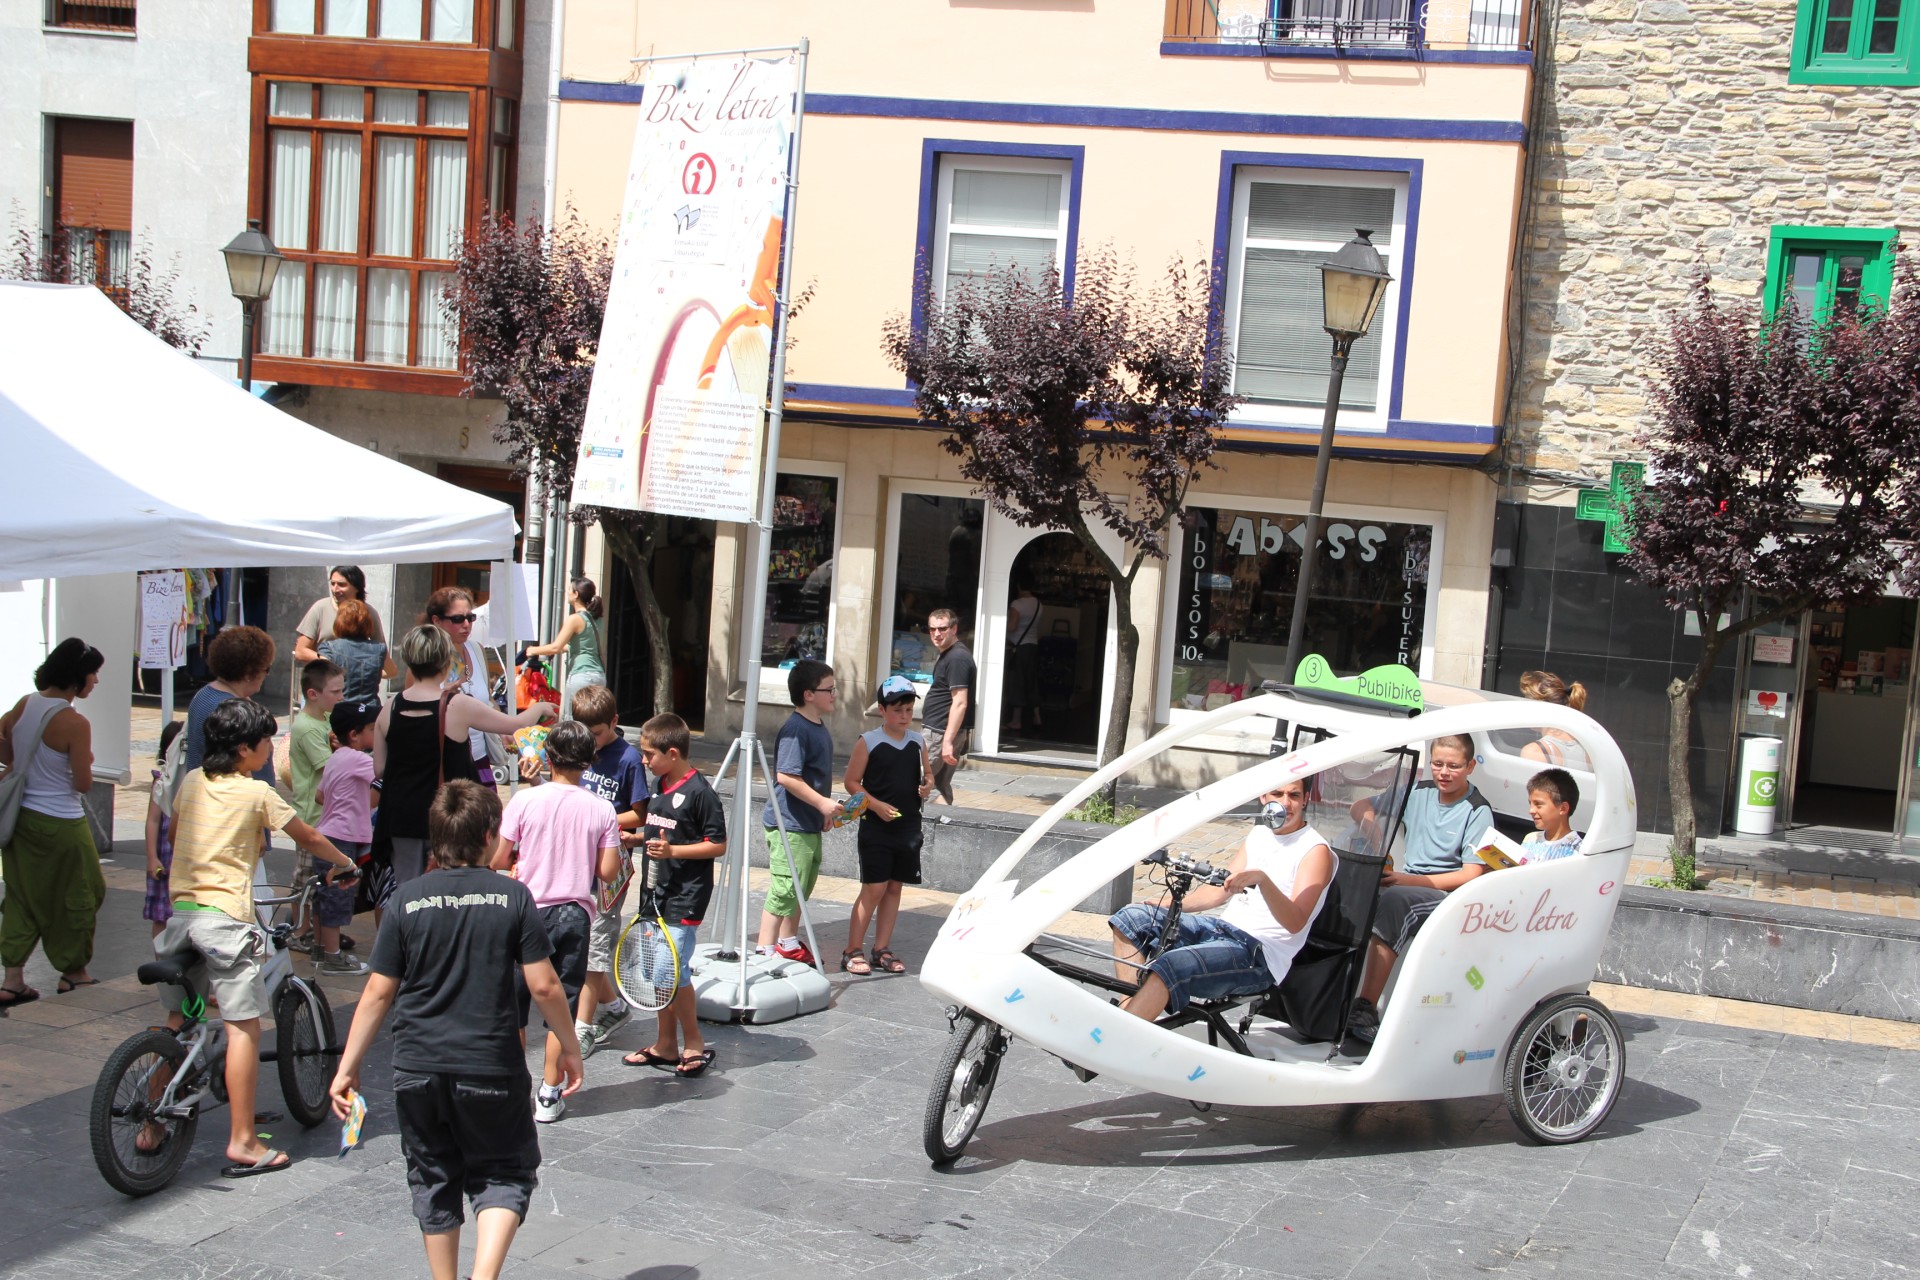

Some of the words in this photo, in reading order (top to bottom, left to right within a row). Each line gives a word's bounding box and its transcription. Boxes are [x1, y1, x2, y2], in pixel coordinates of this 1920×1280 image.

[644, 83, 712, 134] Bizi
[715, 61, 787, 121] letra
[1181, 644, 1204, 662] 10€
[1357, 676, 1422, 703] Publibike
[582, 769, 620, 791] aurten
[596, 784, 617, 801] bai
[444, 893, 509, 910] MAIDEN
[1460, 898, 1519, 936] Bizi
[1525, 887, 1579, 933] letra
